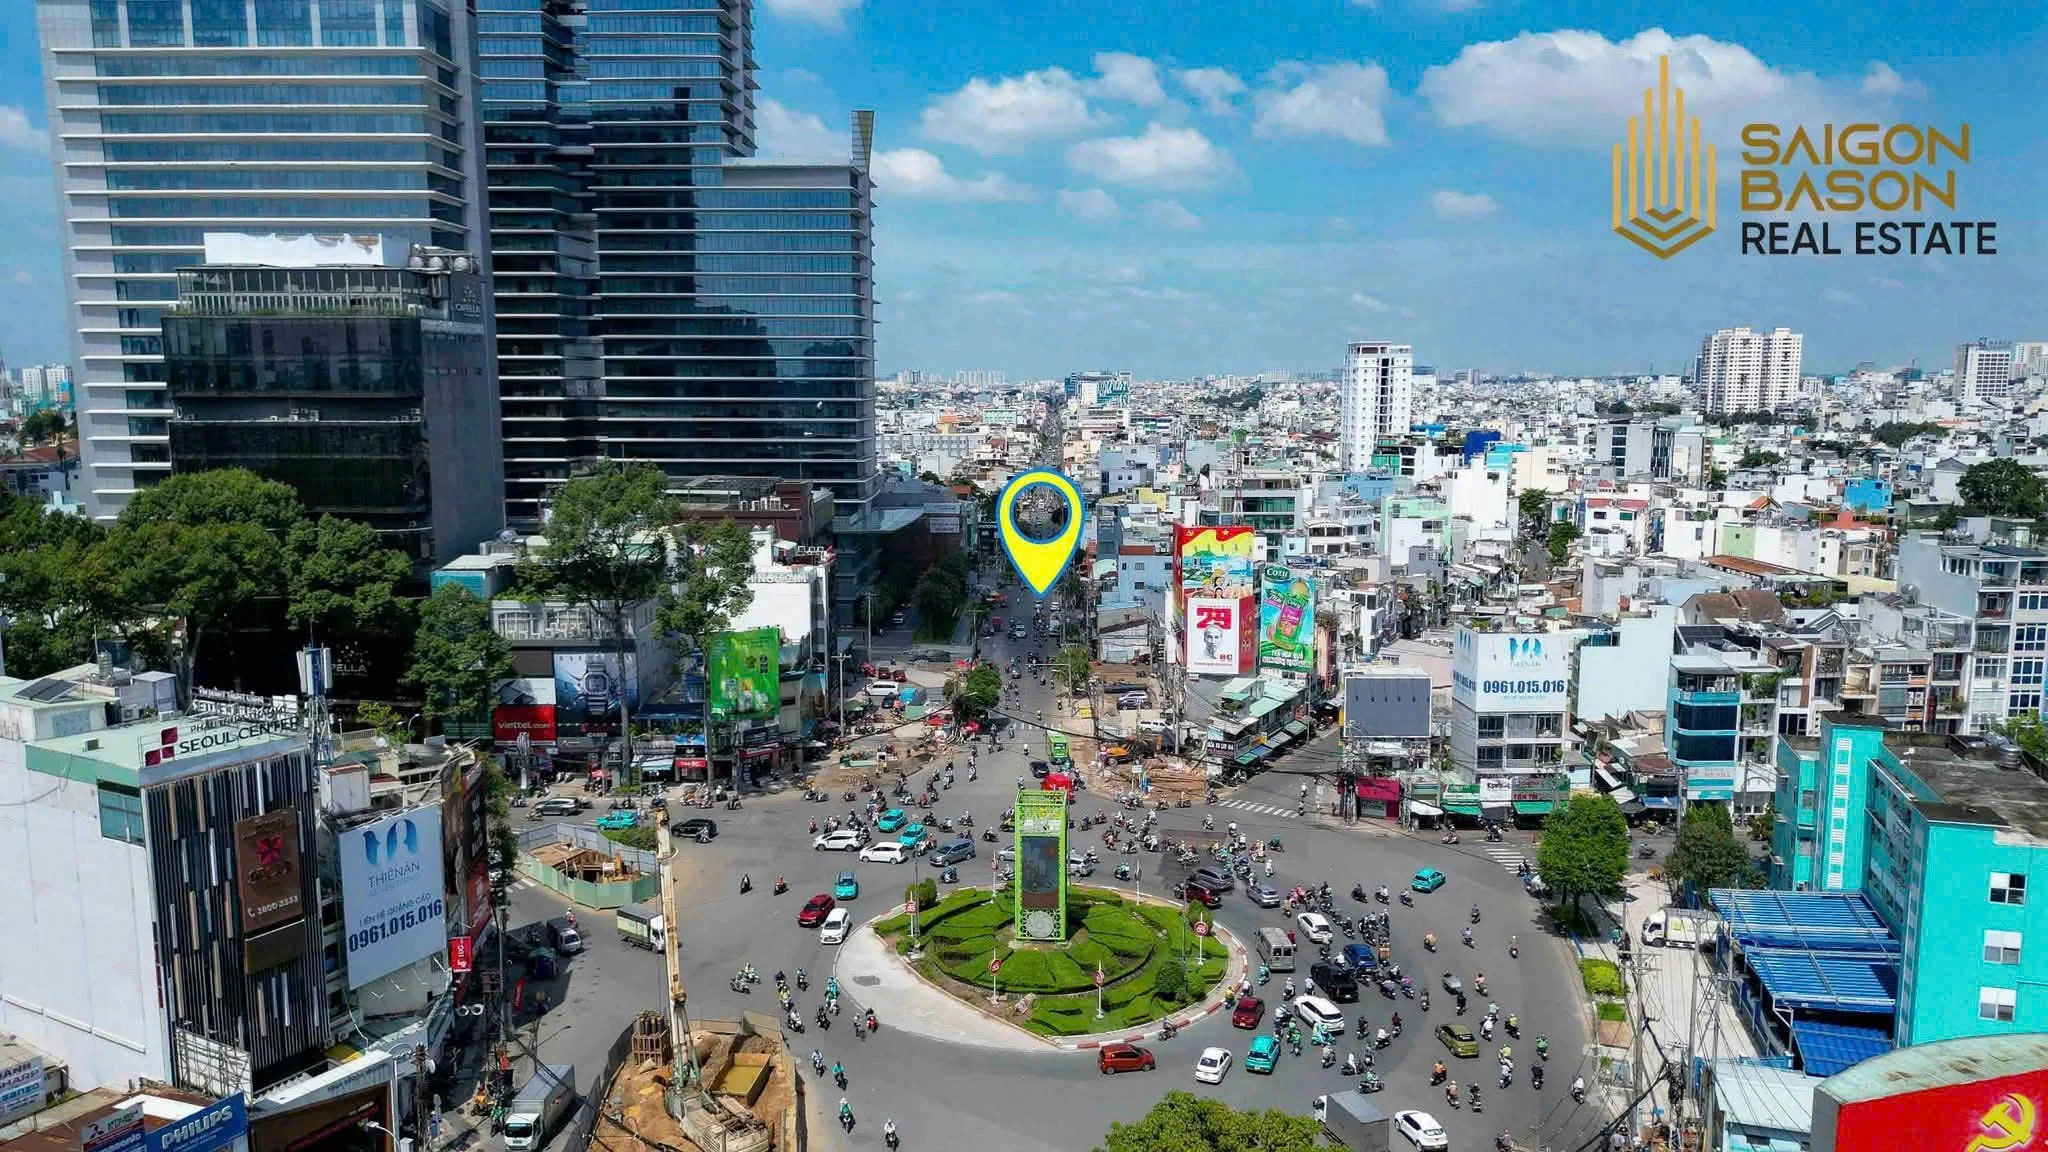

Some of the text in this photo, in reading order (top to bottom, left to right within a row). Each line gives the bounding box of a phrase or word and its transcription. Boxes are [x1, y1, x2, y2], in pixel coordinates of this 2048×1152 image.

[331, 664, 367, 672] PELLA
[1484, 680, 1564, 693] 0961.015.016
[179, 717, 298, 754] SEOUL CENTER
[349, 899, 442, 952] 0961.015.016
[0, 1069, 40, 1089] HARP
[161, 1105, 233, 1150] PHILIPS
